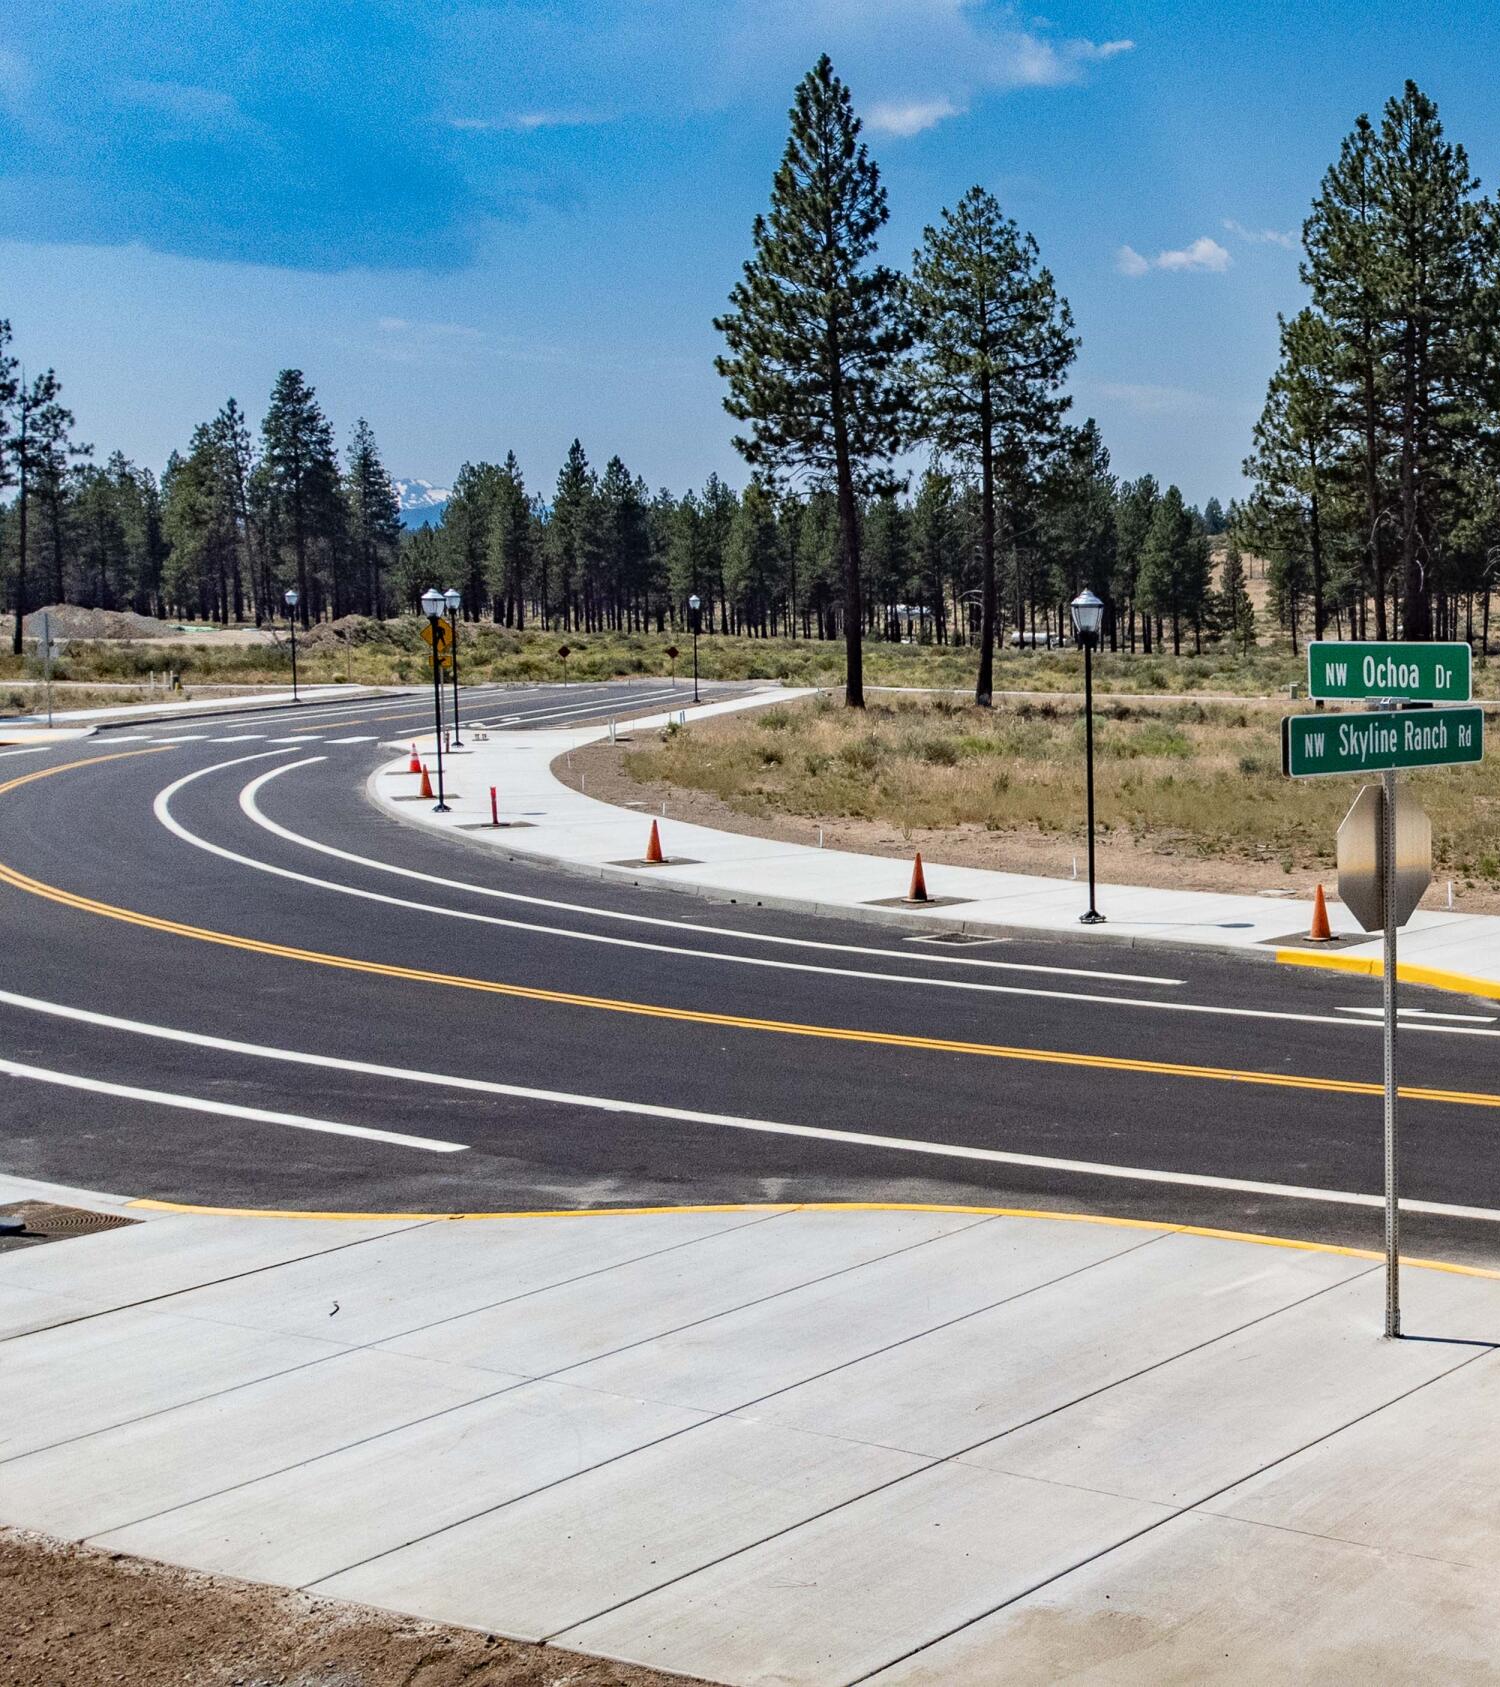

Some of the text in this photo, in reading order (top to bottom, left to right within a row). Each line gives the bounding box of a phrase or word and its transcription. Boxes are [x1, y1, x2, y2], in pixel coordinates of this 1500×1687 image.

[1325, 655, 1452, 688] NW Ochoa Dr
[1304, 720, 1472, 762] NW Skyline Ranch Rd
